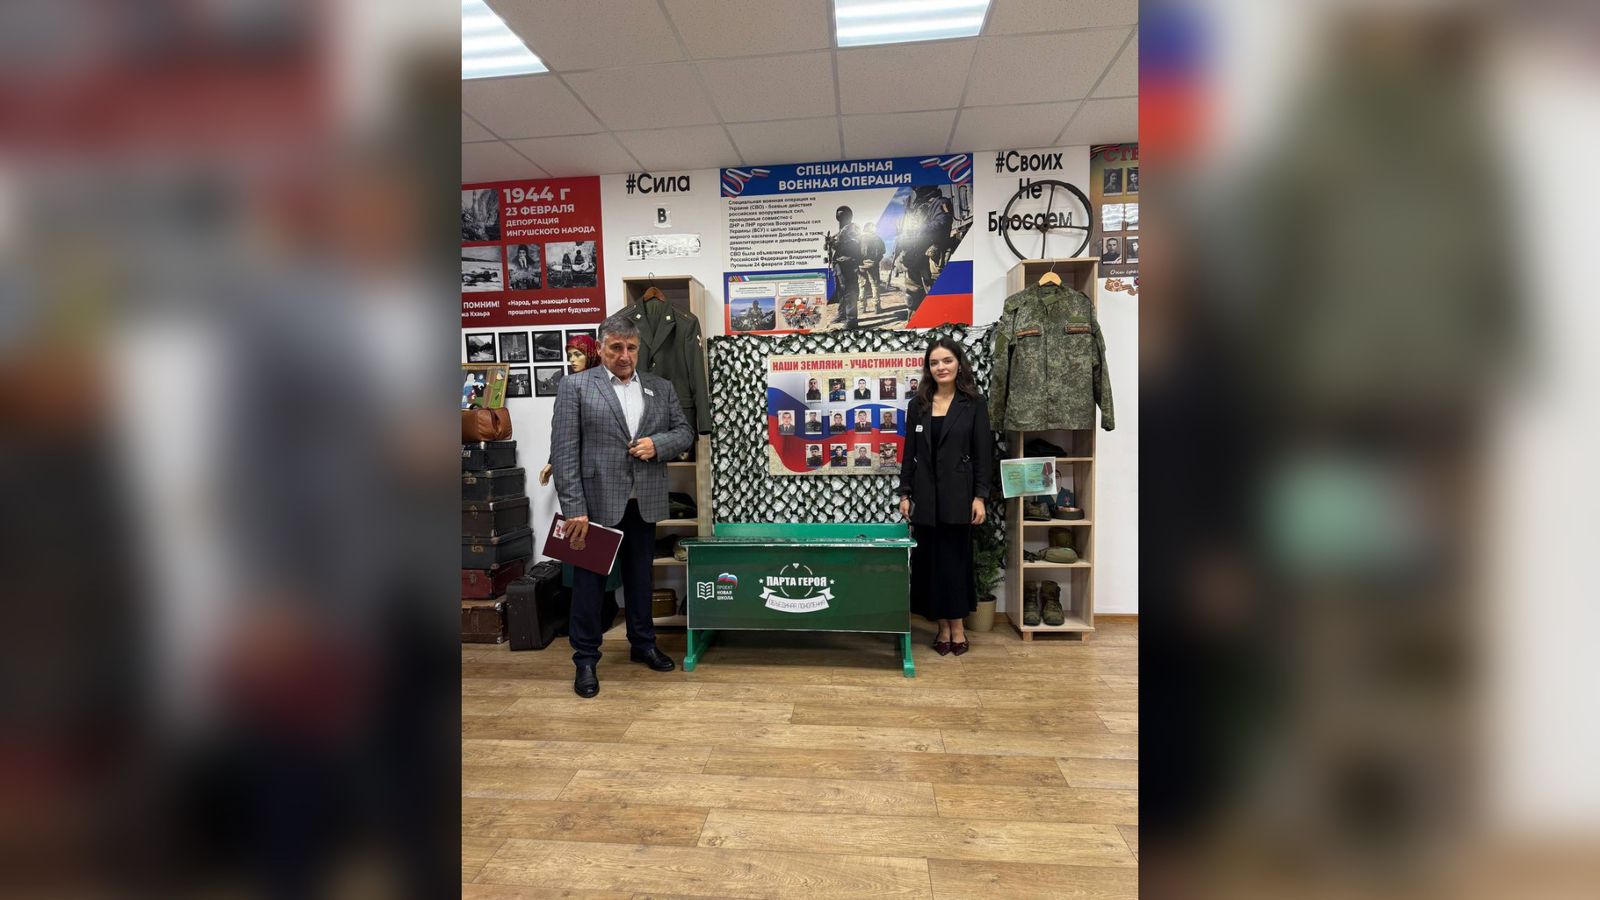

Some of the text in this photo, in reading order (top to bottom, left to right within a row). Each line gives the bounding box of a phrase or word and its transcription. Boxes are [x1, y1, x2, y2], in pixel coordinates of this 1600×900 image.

[796, 160, 893, 177] СПЕЦИАЛЬНАЯ
[996, 150, 1063, 173] #Своих
[626, 173, 690, 194] #Сила
[778, 173, 912, 191] ВОЕННАЯ ОПЕРАЦИЯ
[1018, 178, 1042, 199] Не
[503, 186, 571, 204] 1944 г
[506, 204, 575, 216] 23 ФЕВРАЛЯ
[506, 218, 559, 227] ДЕПОРТАЦИЯ
[988, 211, 1073, 236] Бросаем
[506, 228, 560, 237] ИНГУШСКОГО
[463, 300, 500, 309] ПОМНИМ!
[508, 298, 531, 307] «Народ,
[772, 360, 798, 371] НАШИ
[800, 360, 843, 370] ЗЕМЛЯКИ
[850, 358, 903, 369] УЧАСТНИКИ
[905, 357, 924, 368] СВО
[766, 576, 827, 586] ПАРТА ГЕРОЯ
